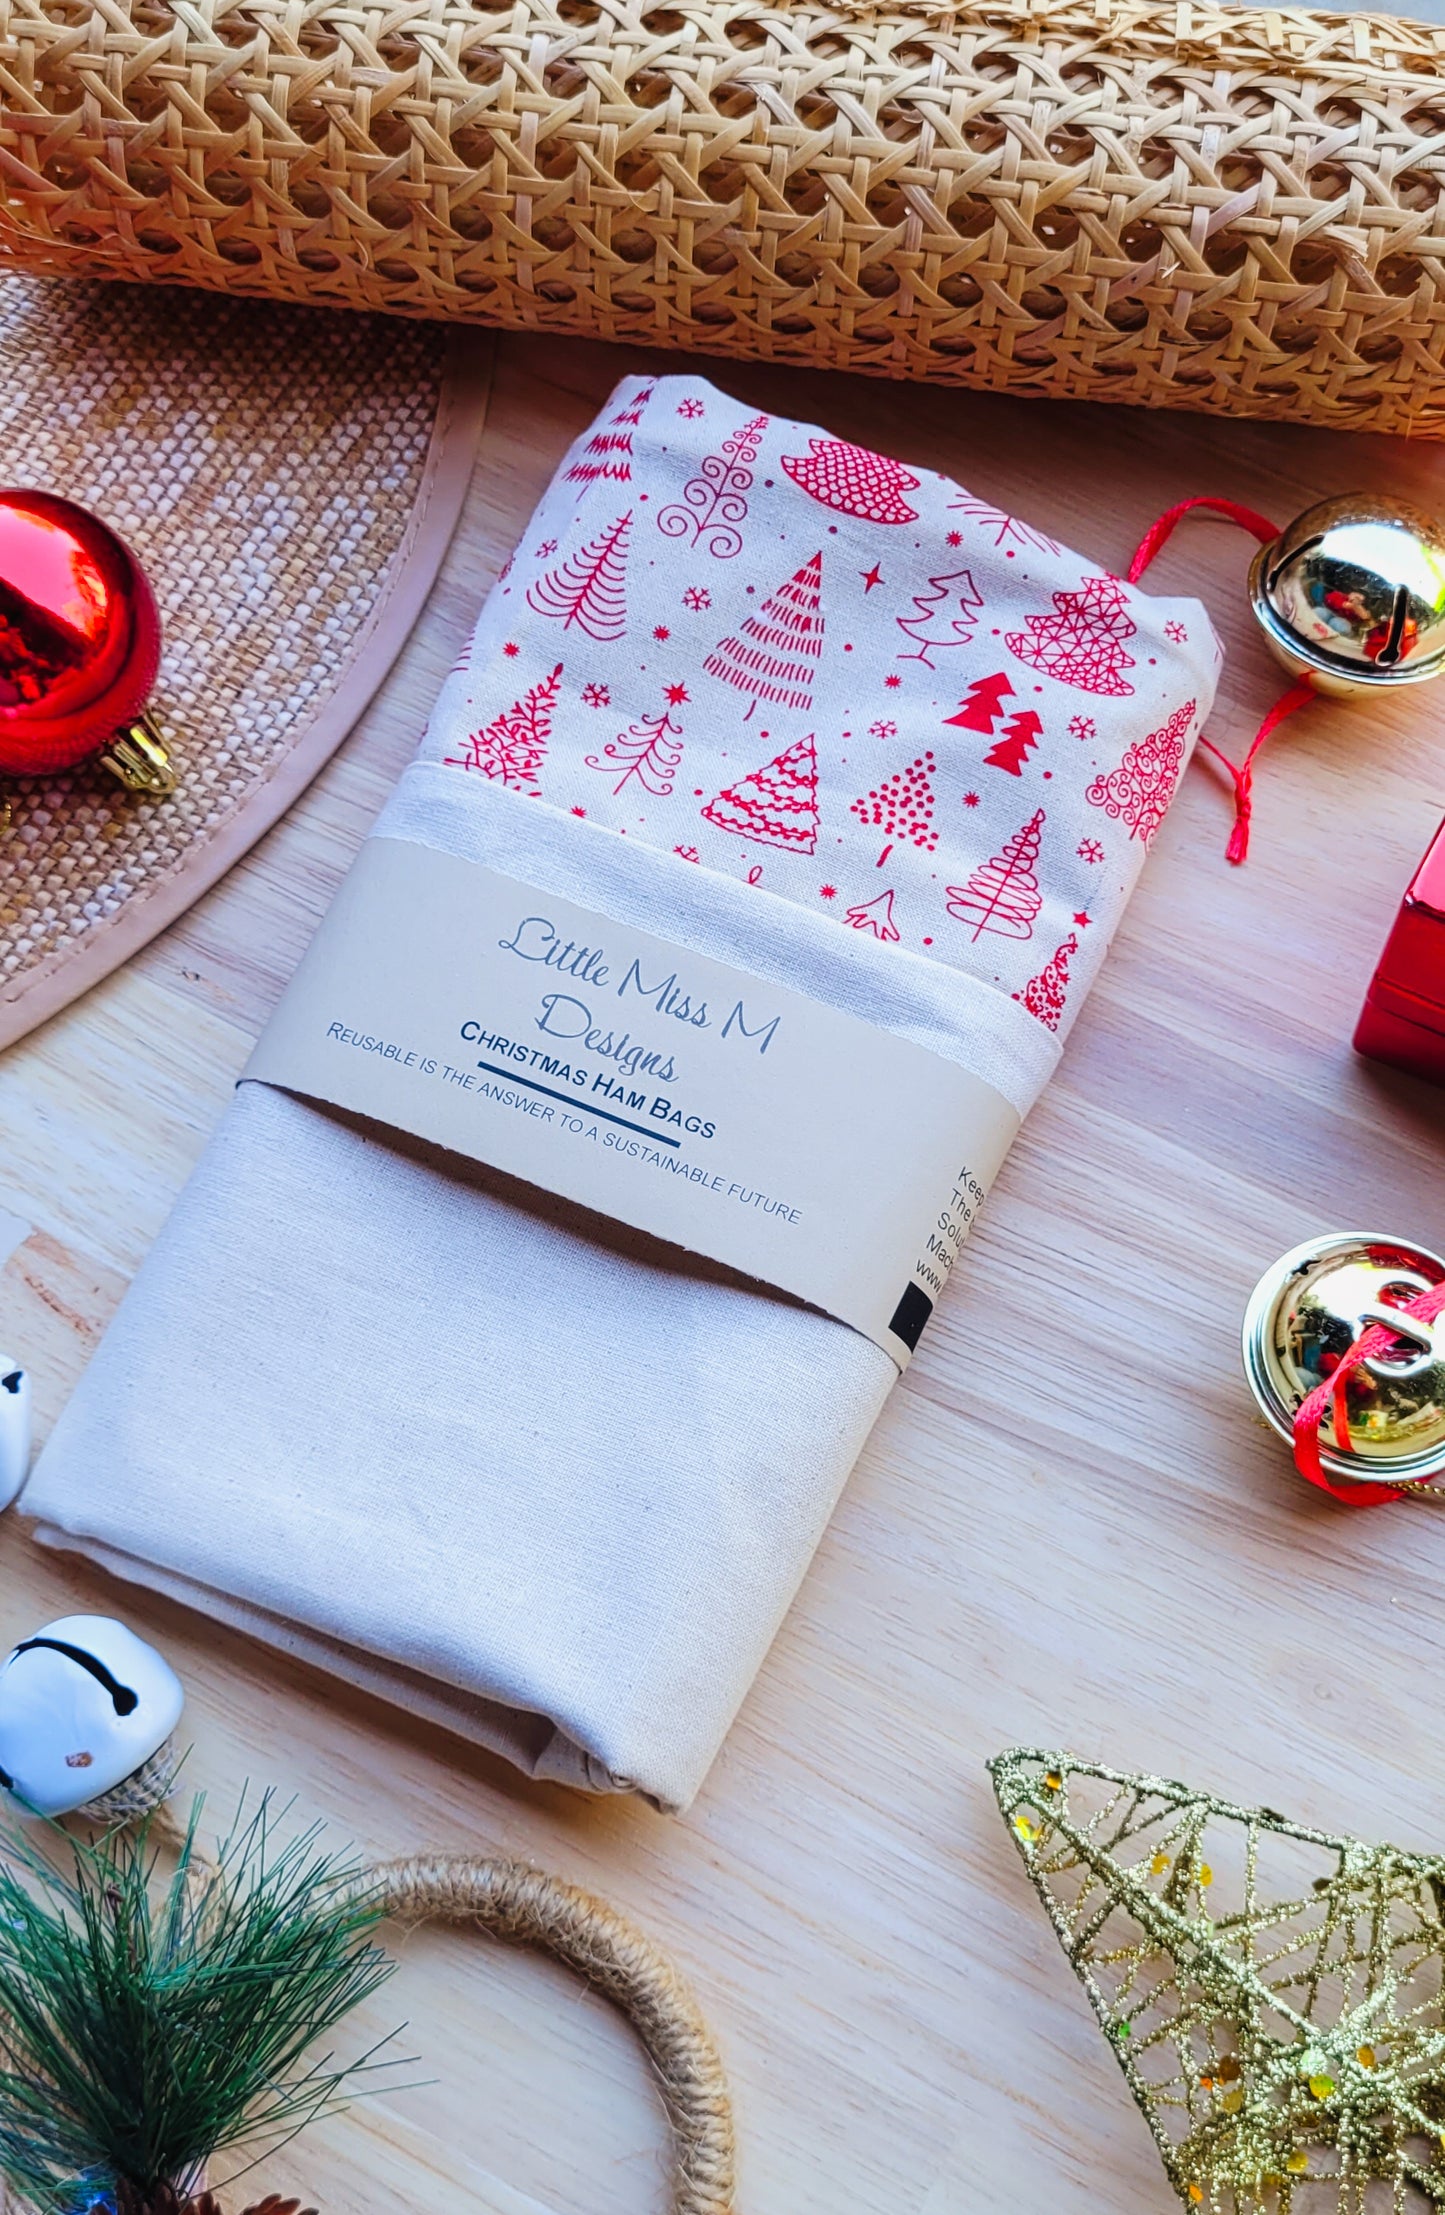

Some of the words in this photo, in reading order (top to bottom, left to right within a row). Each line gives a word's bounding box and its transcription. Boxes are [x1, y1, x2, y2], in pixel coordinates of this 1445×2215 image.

[499, 917, 610, 987] Little
[618, 958, 713, 1028] Miss
[721, 1001, 781, 1055] M
[460, 1021, 588, 1086] CHRISTMAS
[592, 1074, 646, 1111] HAM
[650, 1097, 717, 1138] BAGS
[534, 994, 680, 1083] Designs
[327, 1022, 416, 1067] REUSABLE
[419, 1057, 438, 1074] IS
[443, 1065, 476, 1089] THE
[477, 1082, 555, 1123] ANSWER
[560, 1113, 583, 1133] TO
[585, 1126, 599, 1139] A
[603, 1132, 726, 1192] SUSTAINABLE
[728, 1184, 803, 1225] FUTURE
[950, 1188, 970, 1221] The
[958, 1167, 985, 1207] Keep
